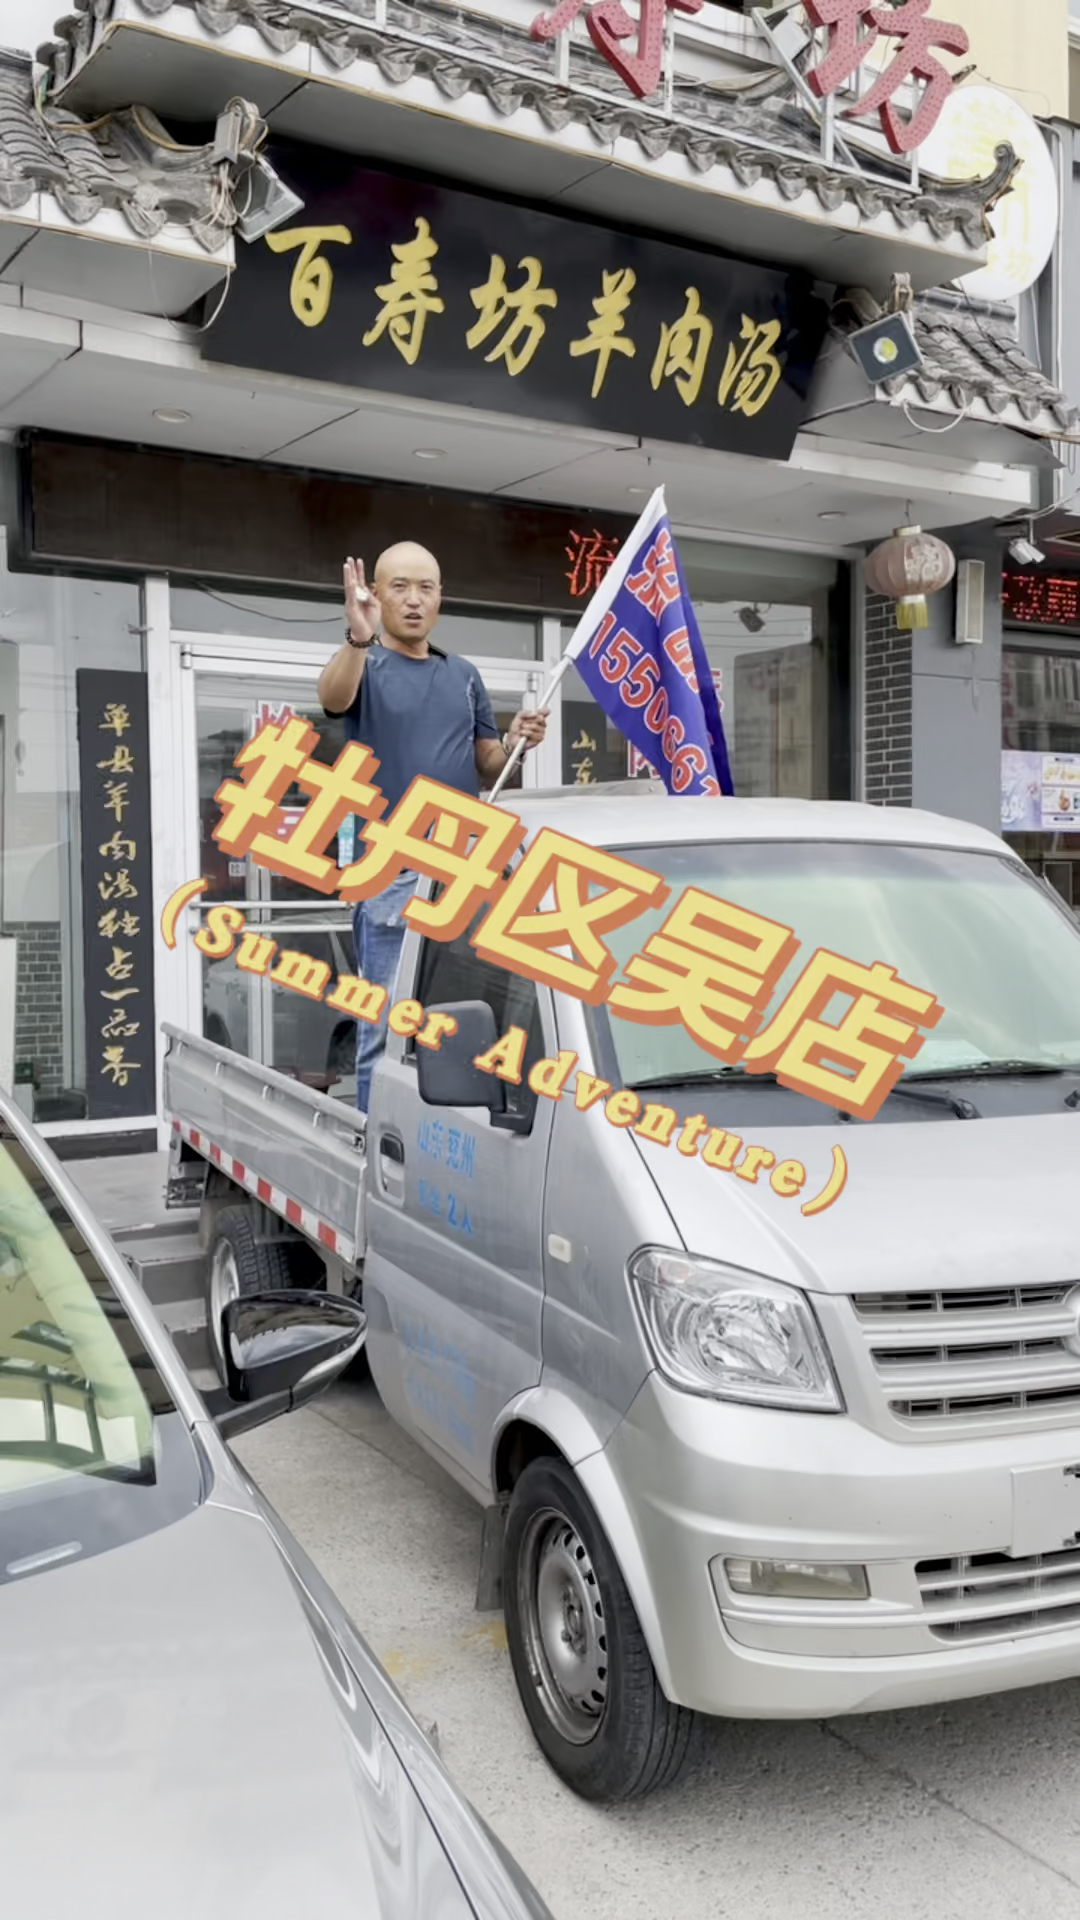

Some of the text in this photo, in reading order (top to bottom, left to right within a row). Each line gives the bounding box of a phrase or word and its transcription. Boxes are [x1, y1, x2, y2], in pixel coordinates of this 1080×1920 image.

[264, 216, 781, 416] 百寿坊羊肉汤
